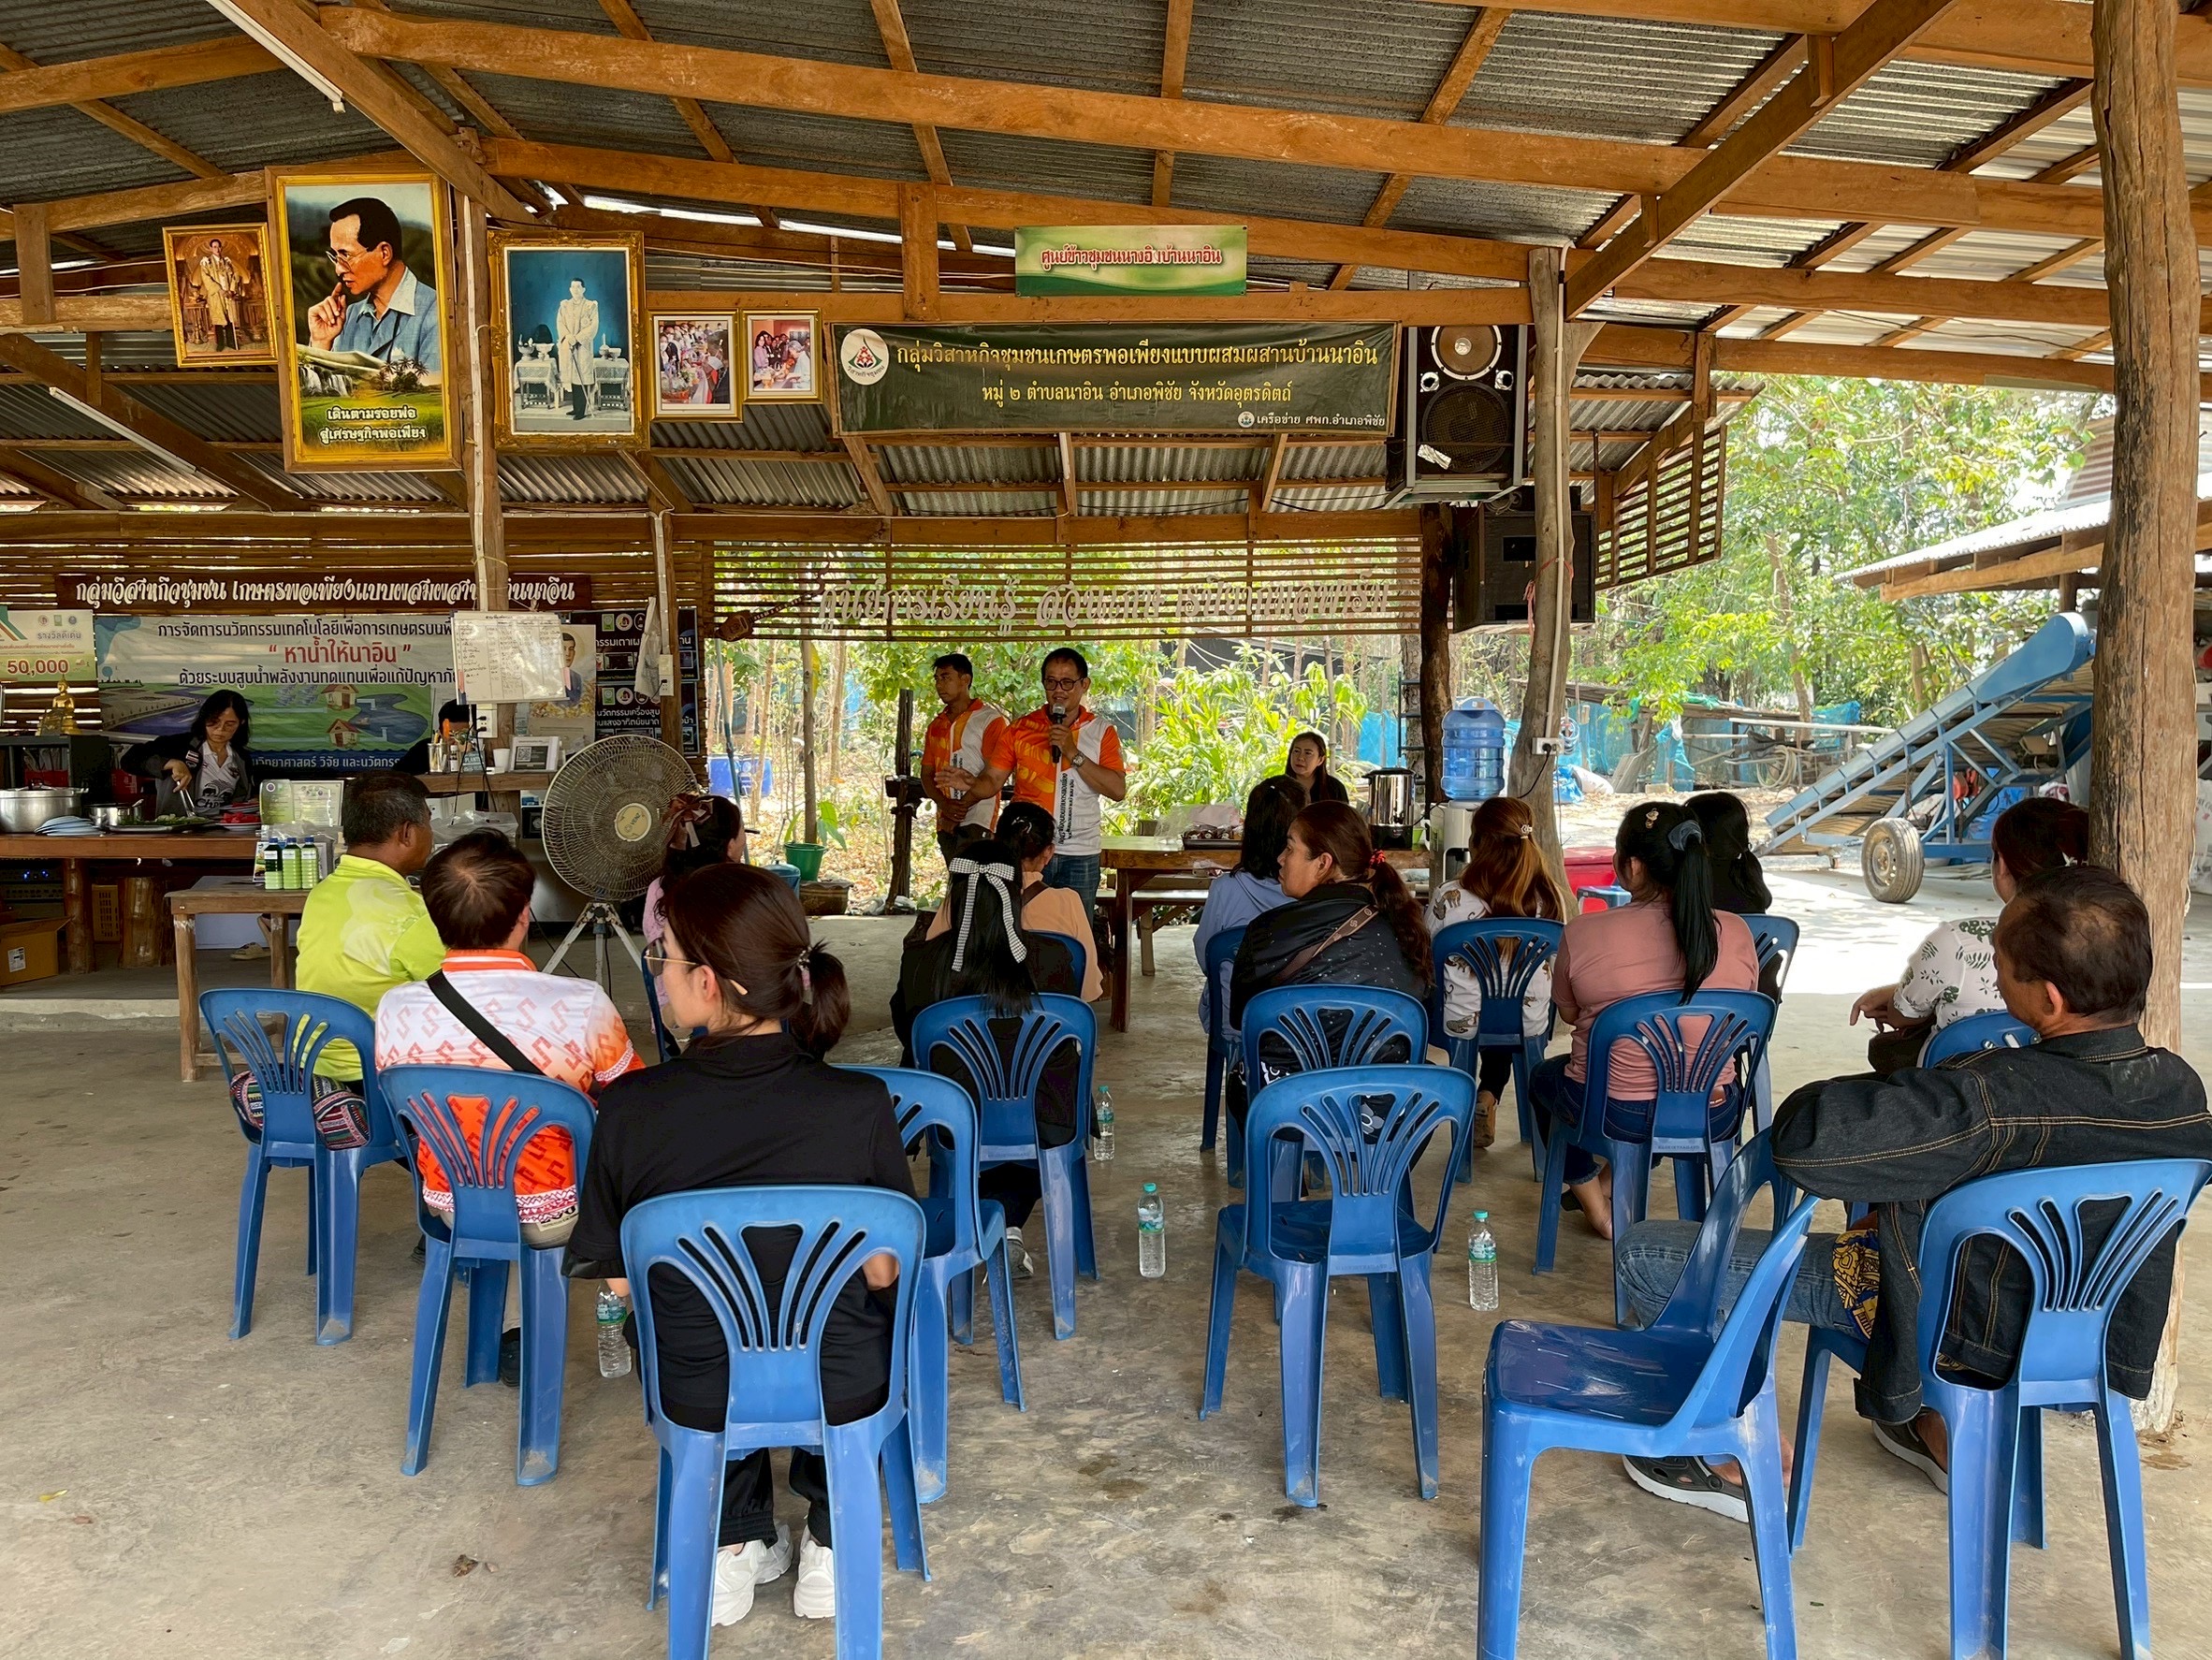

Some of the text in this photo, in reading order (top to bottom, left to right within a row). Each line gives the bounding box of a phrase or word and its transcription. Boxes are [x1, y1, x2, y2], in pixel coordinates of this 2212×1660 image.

[897, 339, 1378, 372] กลุ่มวิสาหกิจชุมชนเกษตรพอเพียงแบบผสมผสานบ้านนาอิน
[982, 379, 1293, 409] หมู่ ๒ ตำบลนาอิน อำเภอพิชัย จังหวัดอุตรดิตถ์
[327, 404, 417, 420] เดินตามรอยพ่อ
[1257, 412, 1386, 427] เครือข่าย ศพก.อำเภอพิชัย
[319, 424, 427, 444] สู่เศรษฐกิจพอเพียง
[819, 576, 1021, 635] ศูนย์การเรียนรู้
[284, 638, 397, 663] หาน้ำให้นาอิน
[7, 659, 69, 676] 50,000
[179, 663, 456, 689] ด้วยระบบสูบน้ำพลังงานทดแทนเพื่อแก้ปัญหาภั
[320, 755, 340, 767] วิจัย
